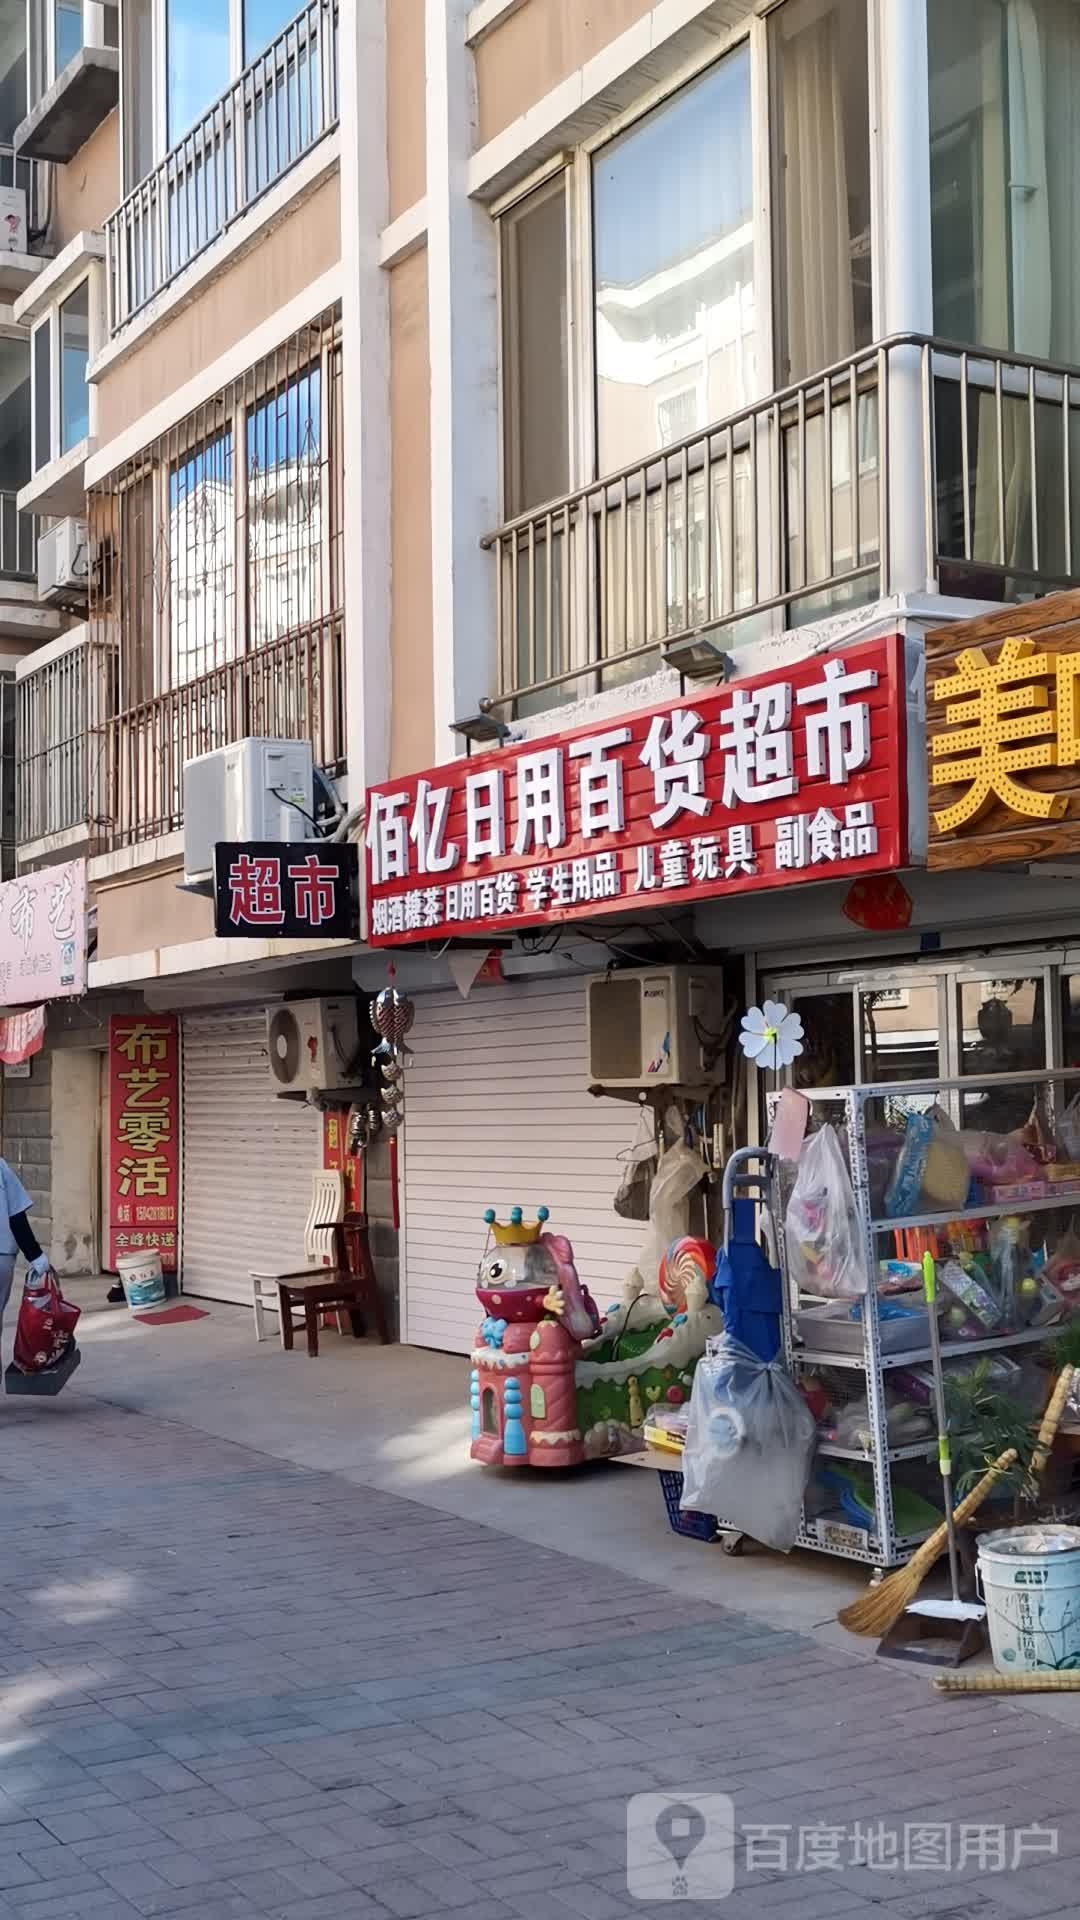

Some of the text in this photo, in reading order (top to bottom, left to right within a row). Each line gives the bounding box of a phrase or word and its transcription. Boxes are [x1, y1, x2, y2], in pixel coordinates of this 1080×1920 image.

[365, 658, 878, 885] 佰亿日用百货超市
[932, 636, 1080, 833] 美
[228, 854, 339, 925] 超市
[372, 802, 878, 935] 烟酒糖茶 日用百货 学生用品 儿童玩具 副食品
[115, 1023, 172, 1197] 布艺零活
[115, 1231, 175, 1247] 全峰快递
